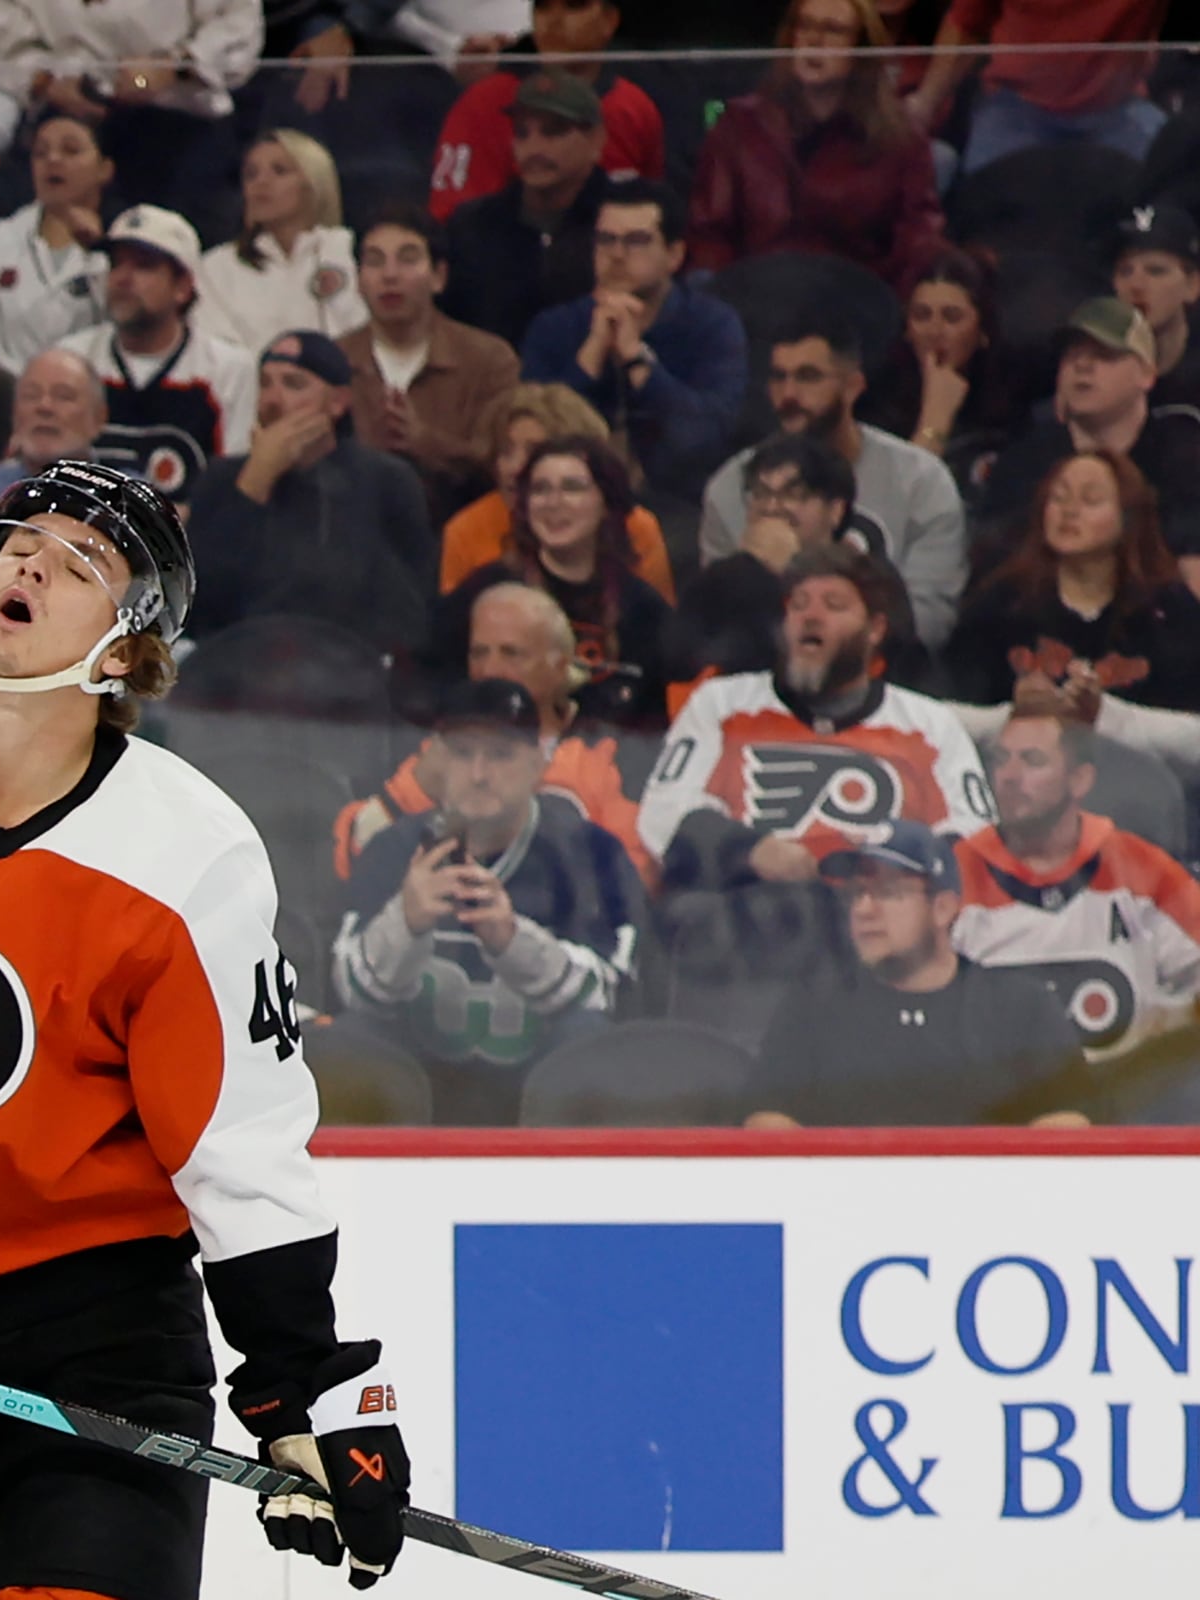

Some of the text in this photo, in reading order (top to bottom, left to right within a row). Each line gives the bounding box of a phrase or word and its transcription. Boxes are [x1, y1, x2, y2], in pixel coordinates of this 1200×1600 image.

[839, 1255, 1193, 1376] CON
[841, 1398, 1200, 1521] & BU
